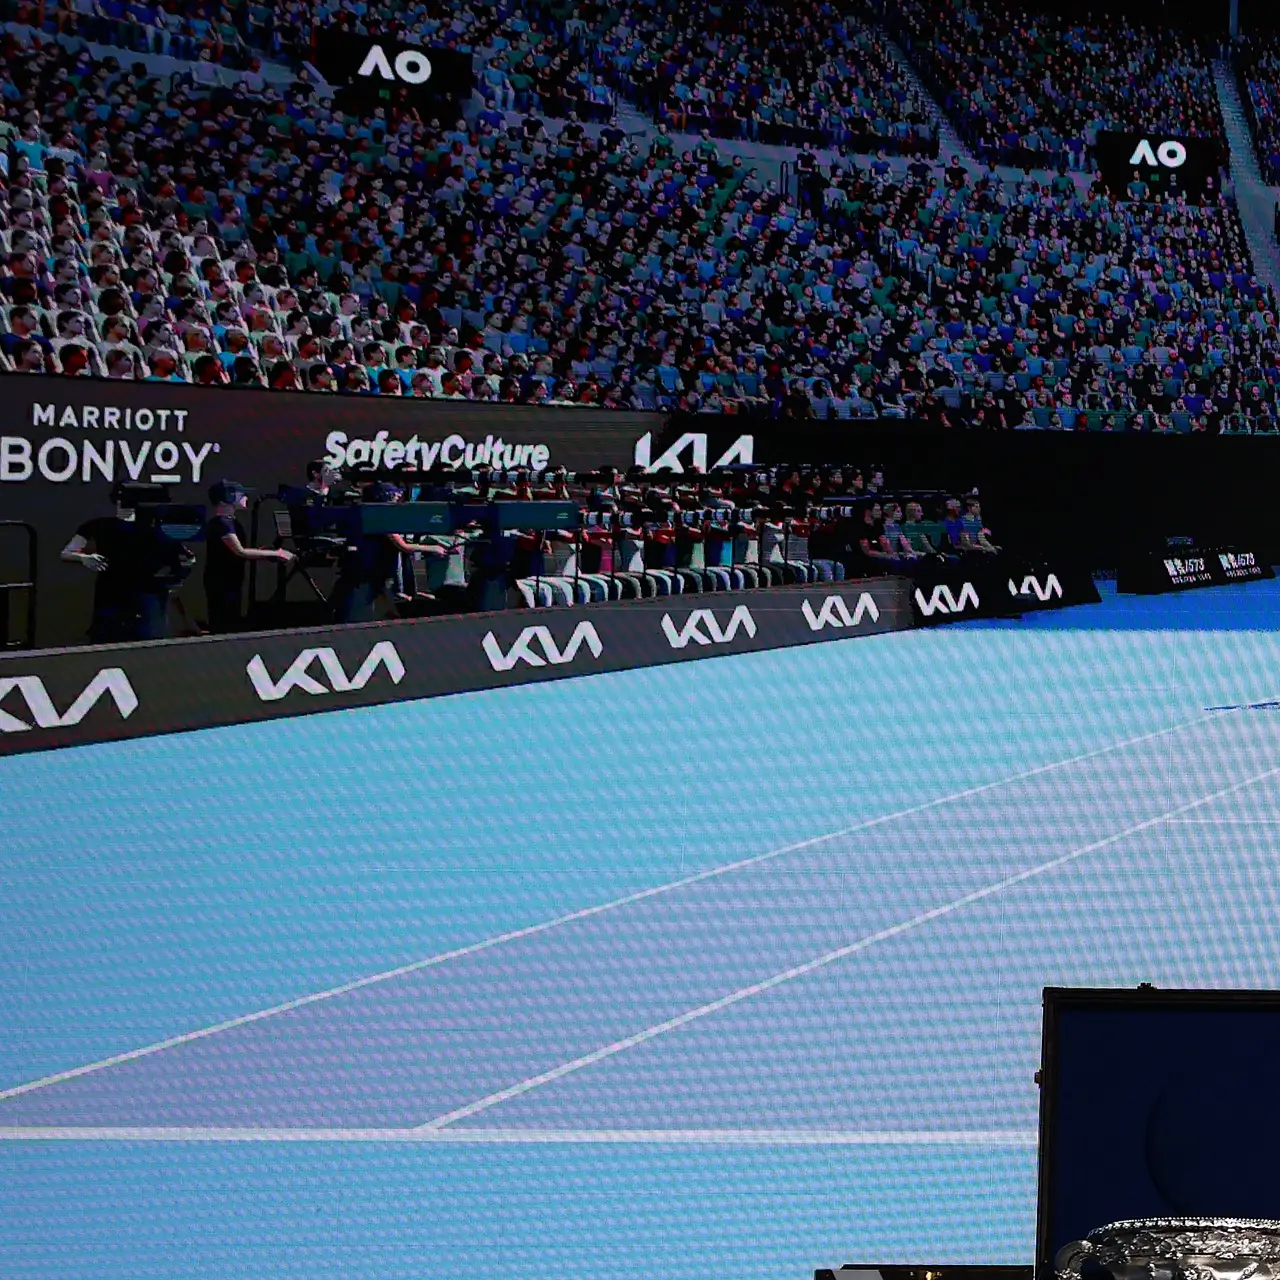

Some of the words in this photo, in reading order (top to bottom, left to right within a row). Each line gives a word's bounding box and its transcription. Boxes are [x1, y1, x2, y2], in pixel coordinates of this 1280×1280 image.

[357, 45, 432, 84] AO
[1129, 139, 1188, 168] AO
[33, 403, 188, 431] MARRIOTT
[0, 437, 213, 483] BONVOY
[324, 430, 551, 472] SafetyCulture
[635, 431, 755, 474] KIA
[802, 591, 880, 632] KIA
[915, 582, 980, 616] KIA
[481, 620, 603, 672] KIA
[661, 604, 757, 649] KIA
[247, 640, 406, 702] KIA
